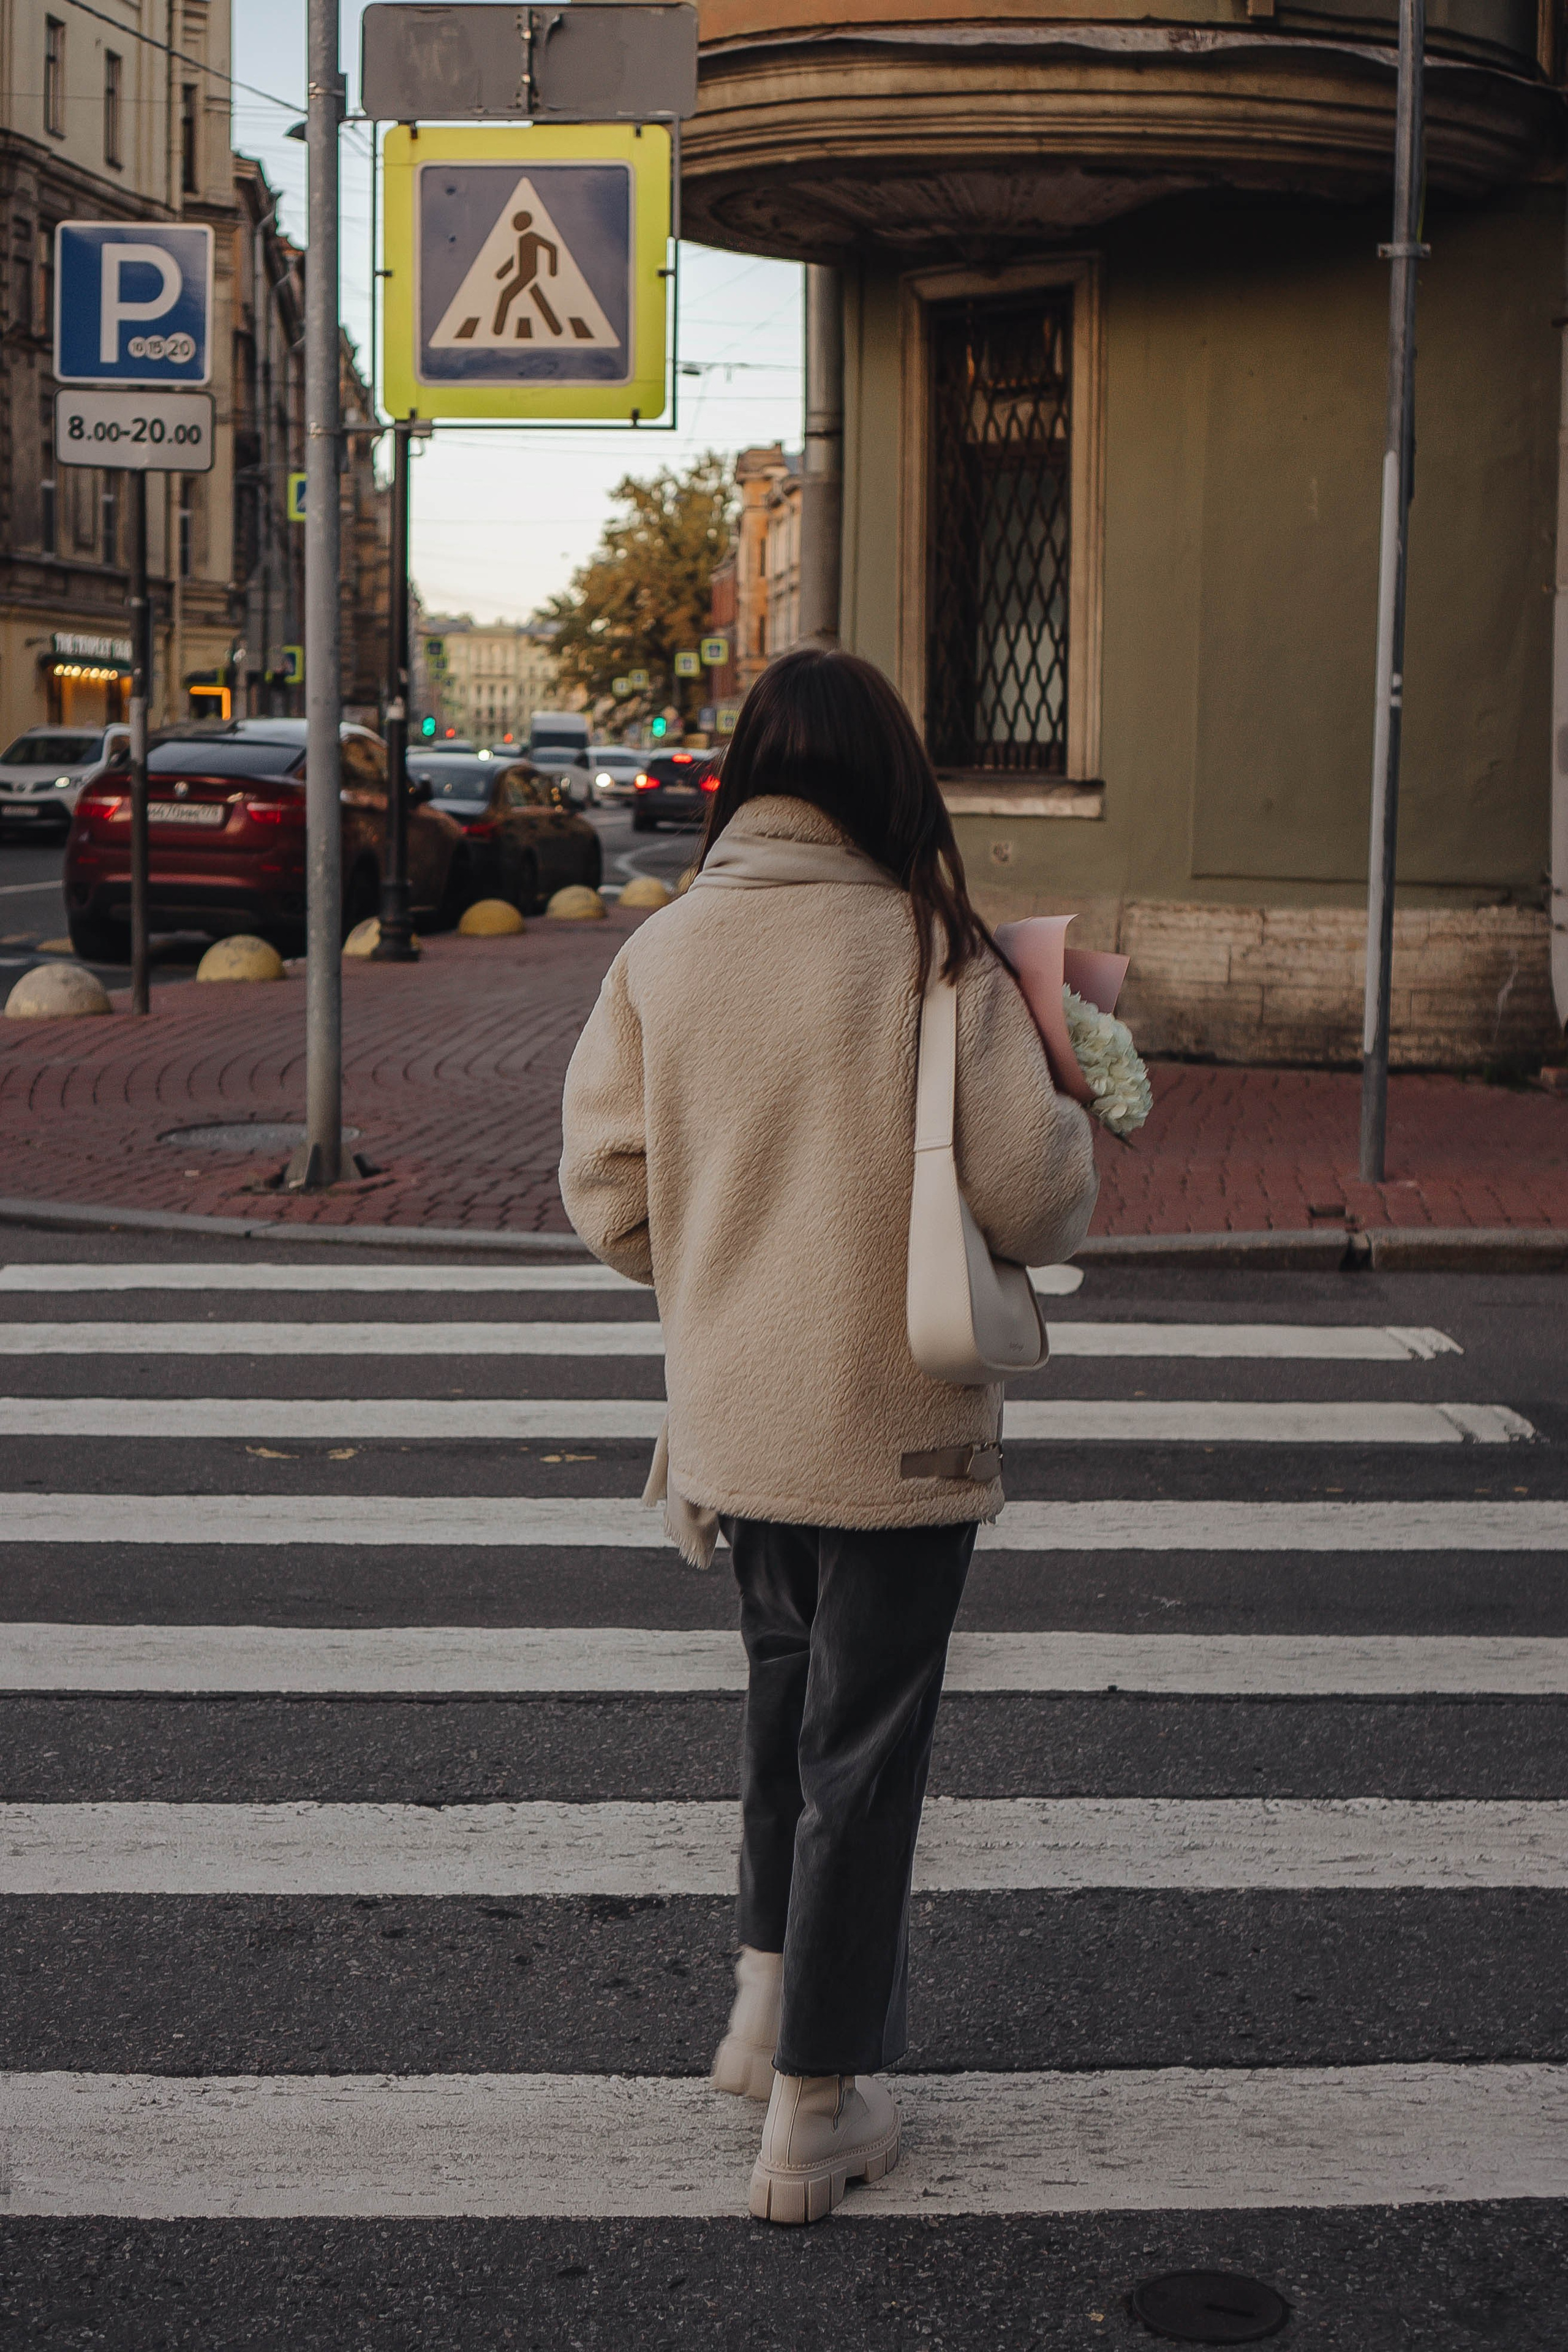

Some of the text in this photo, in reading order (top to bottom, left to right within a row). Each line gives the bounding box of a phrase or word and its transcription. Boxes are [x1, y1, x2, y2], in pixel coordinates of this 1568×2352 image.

[100, 243, 183, 363] P
[167, 339, 190, 356] 20
[68, 415, 202, 445] 8.00-20.00
